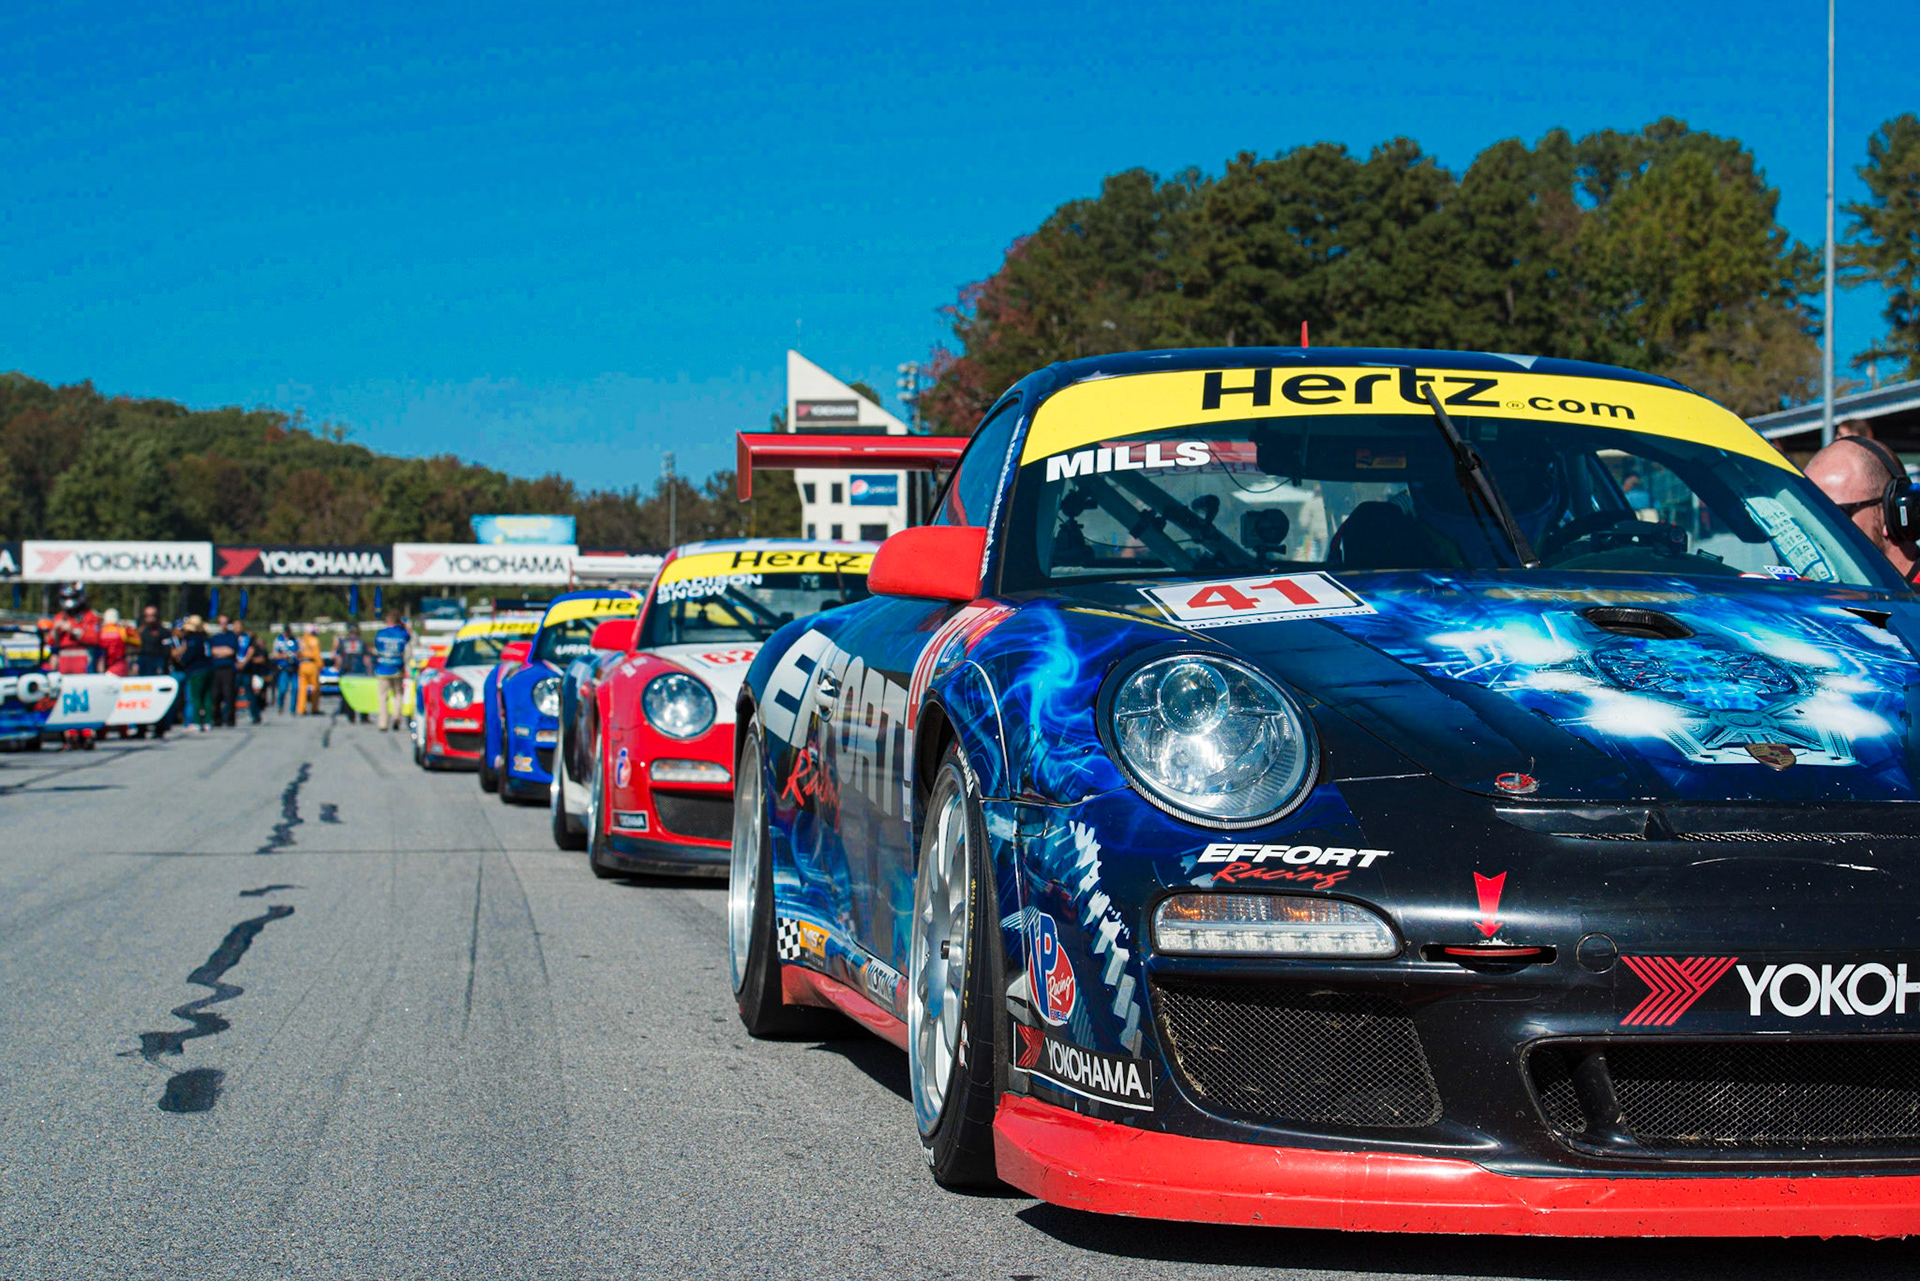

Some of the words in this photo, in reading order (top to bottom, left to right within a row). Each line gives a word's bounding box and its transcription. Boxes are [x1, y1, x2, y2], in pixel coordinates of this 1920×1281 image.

[1046, 441, 1211, 482] MILLS
[75, 552, 200, 572] YOKOHAMA
[259, 551, 388, 574] YOKOHAMA
[445, 555, 566, 573] YOKOHAMA
[731, 551, 862, 569] Hertz
[657, 574, 762, 594] MADISON
[657, 585, 727, 604] SNOW
[1186, 579, 1319, 611] 41
[1197, 843, 1392, 868] EFFORT
[1210, 861, 1351, 889] Racing
[1028, 912, 1058, 1018] VP
[1048, 973, 1075, 1006] Racing
[1044, 1036, 1147, 1100] YOKOHAMA
